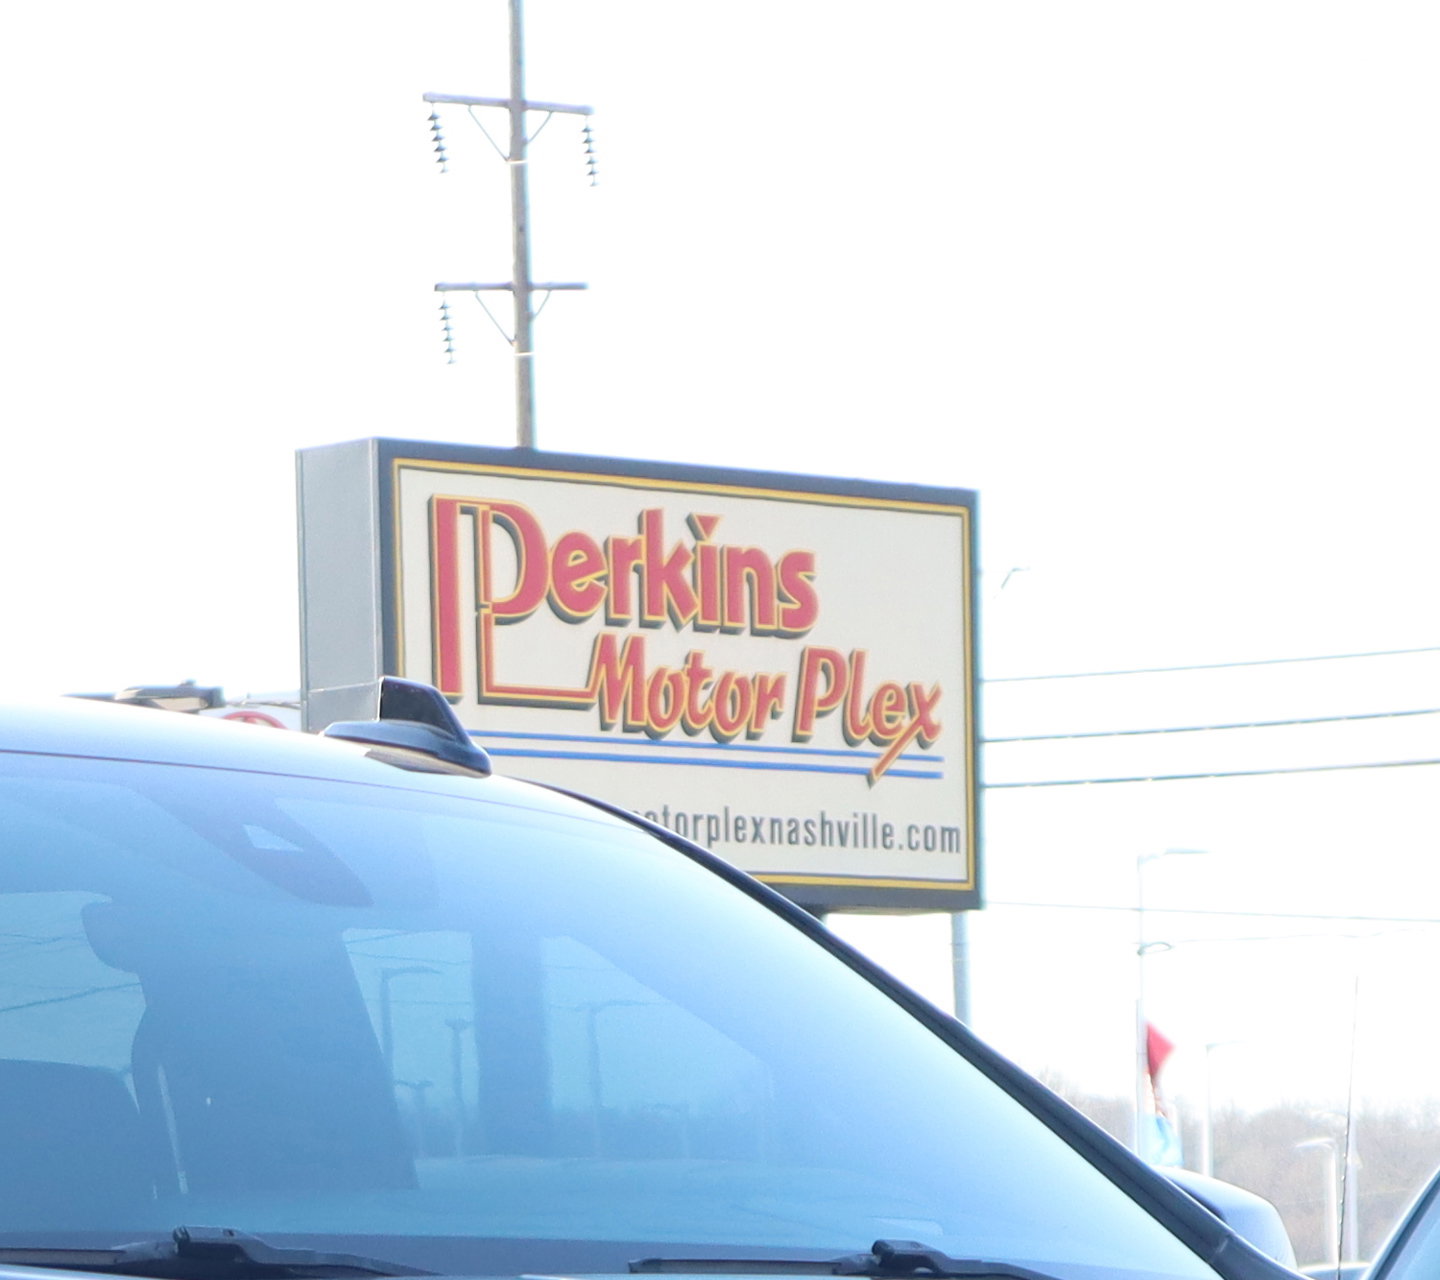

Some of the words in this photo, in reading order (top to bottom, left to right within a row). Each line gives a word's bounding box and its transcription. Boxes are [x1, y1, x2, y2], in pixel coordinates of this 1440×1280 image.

[429, 493, 820, 708] Perkins
[591, 632, 788, 744] Motor
[793, 644, 943, 789] Plex
[632, 803, 961, 854] torplexnashville.com
